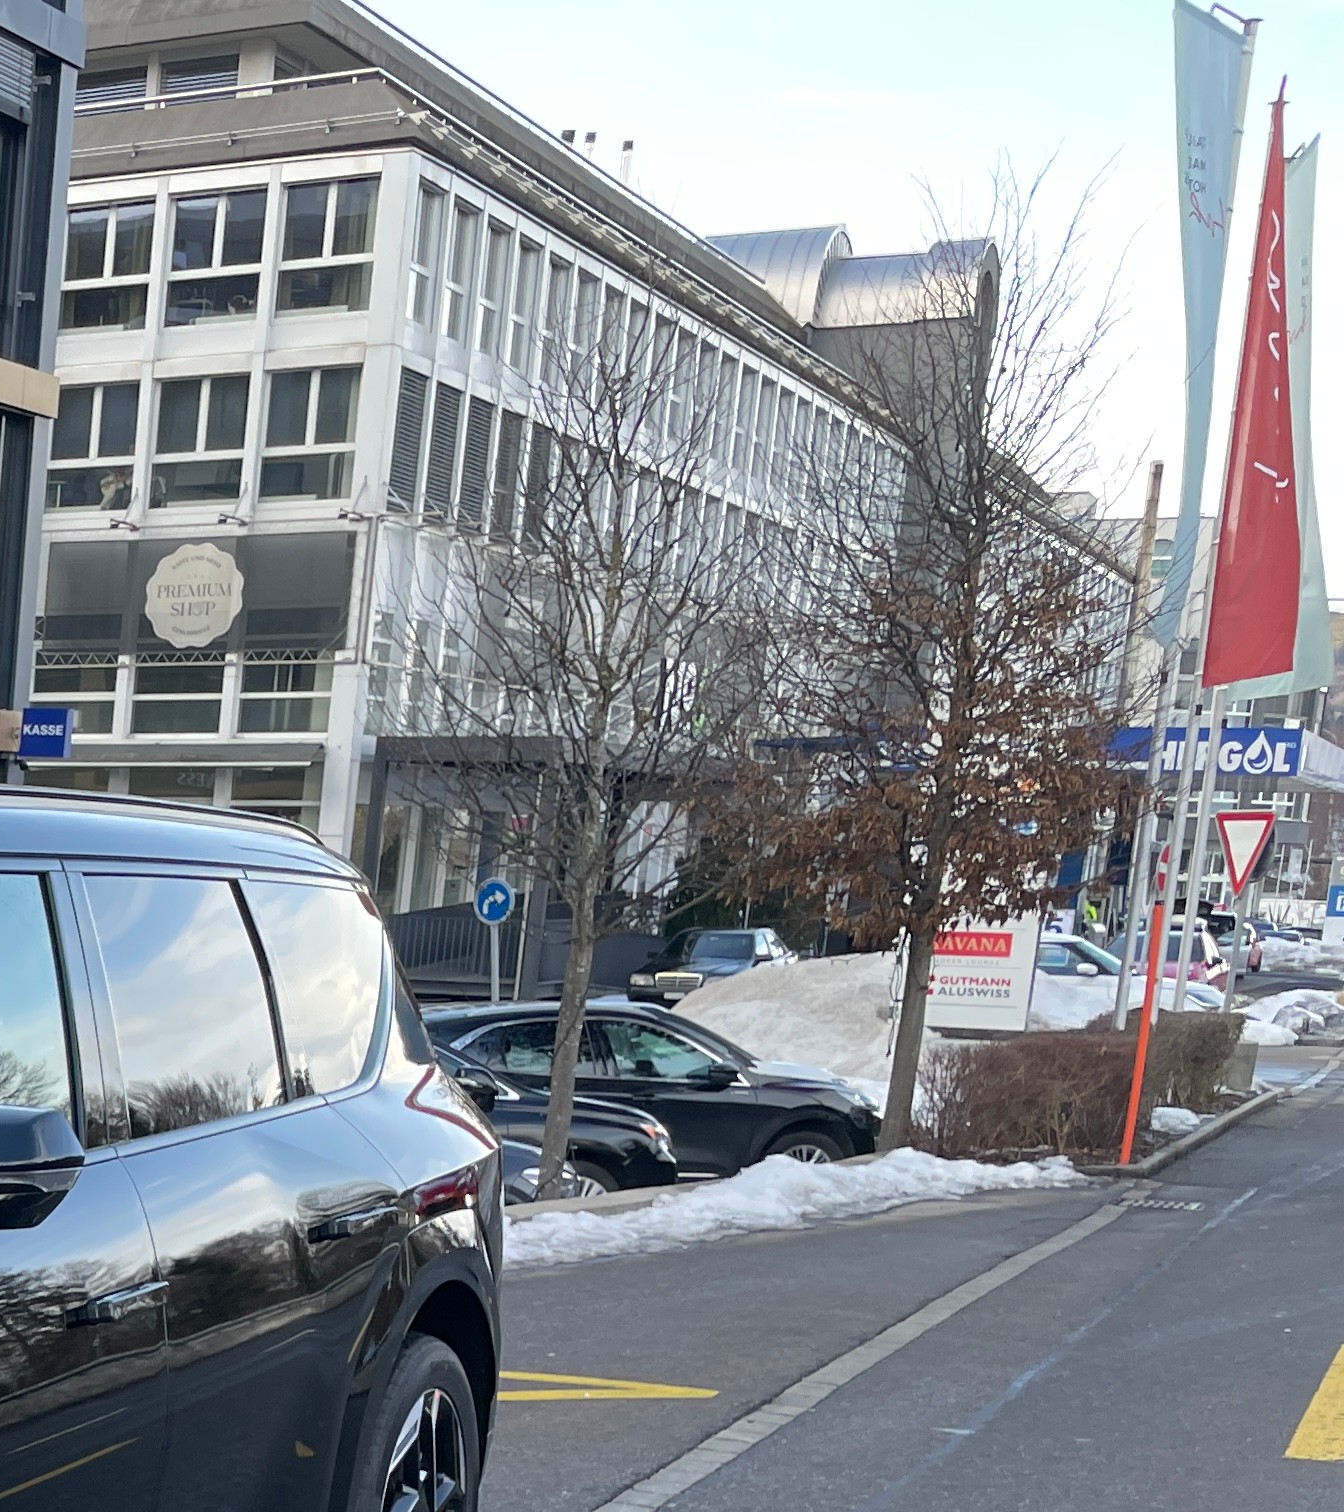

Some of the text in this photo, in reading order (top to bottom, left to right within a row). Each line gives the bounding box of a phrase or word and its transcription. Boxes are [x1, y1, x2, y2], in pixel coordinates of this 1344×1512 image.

[157, 583, 232, 599] PREMIUM
[170, 601, 216, 617] SHOP
[23, 723, 64, 737] KASSE
[939, 976, 1011, 987] GUTMANN
[937, 986, 1011, 999] ALUSWISS
